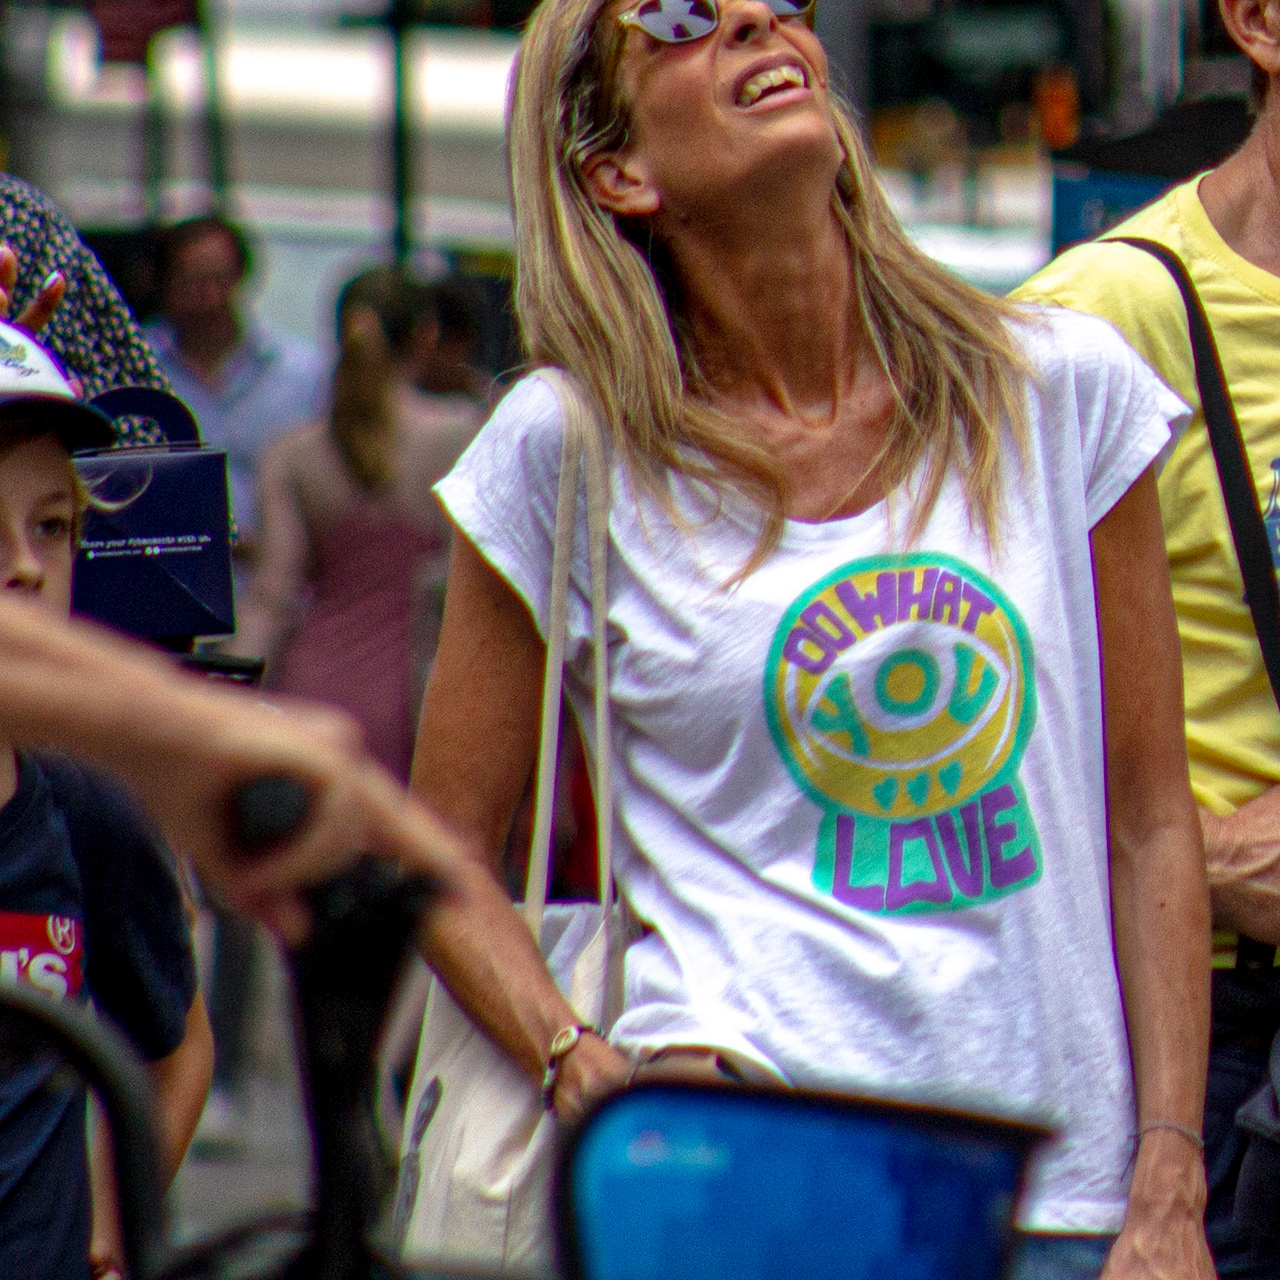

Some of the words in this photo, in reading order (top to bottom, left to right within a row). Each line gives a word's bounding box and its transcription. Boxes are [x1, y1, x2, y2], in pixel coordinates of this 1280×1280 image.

[783, 599, 857, 675] DO
[834, 566, 998, 634] WHAT
[832, 783, 1037, 912] LOVE
